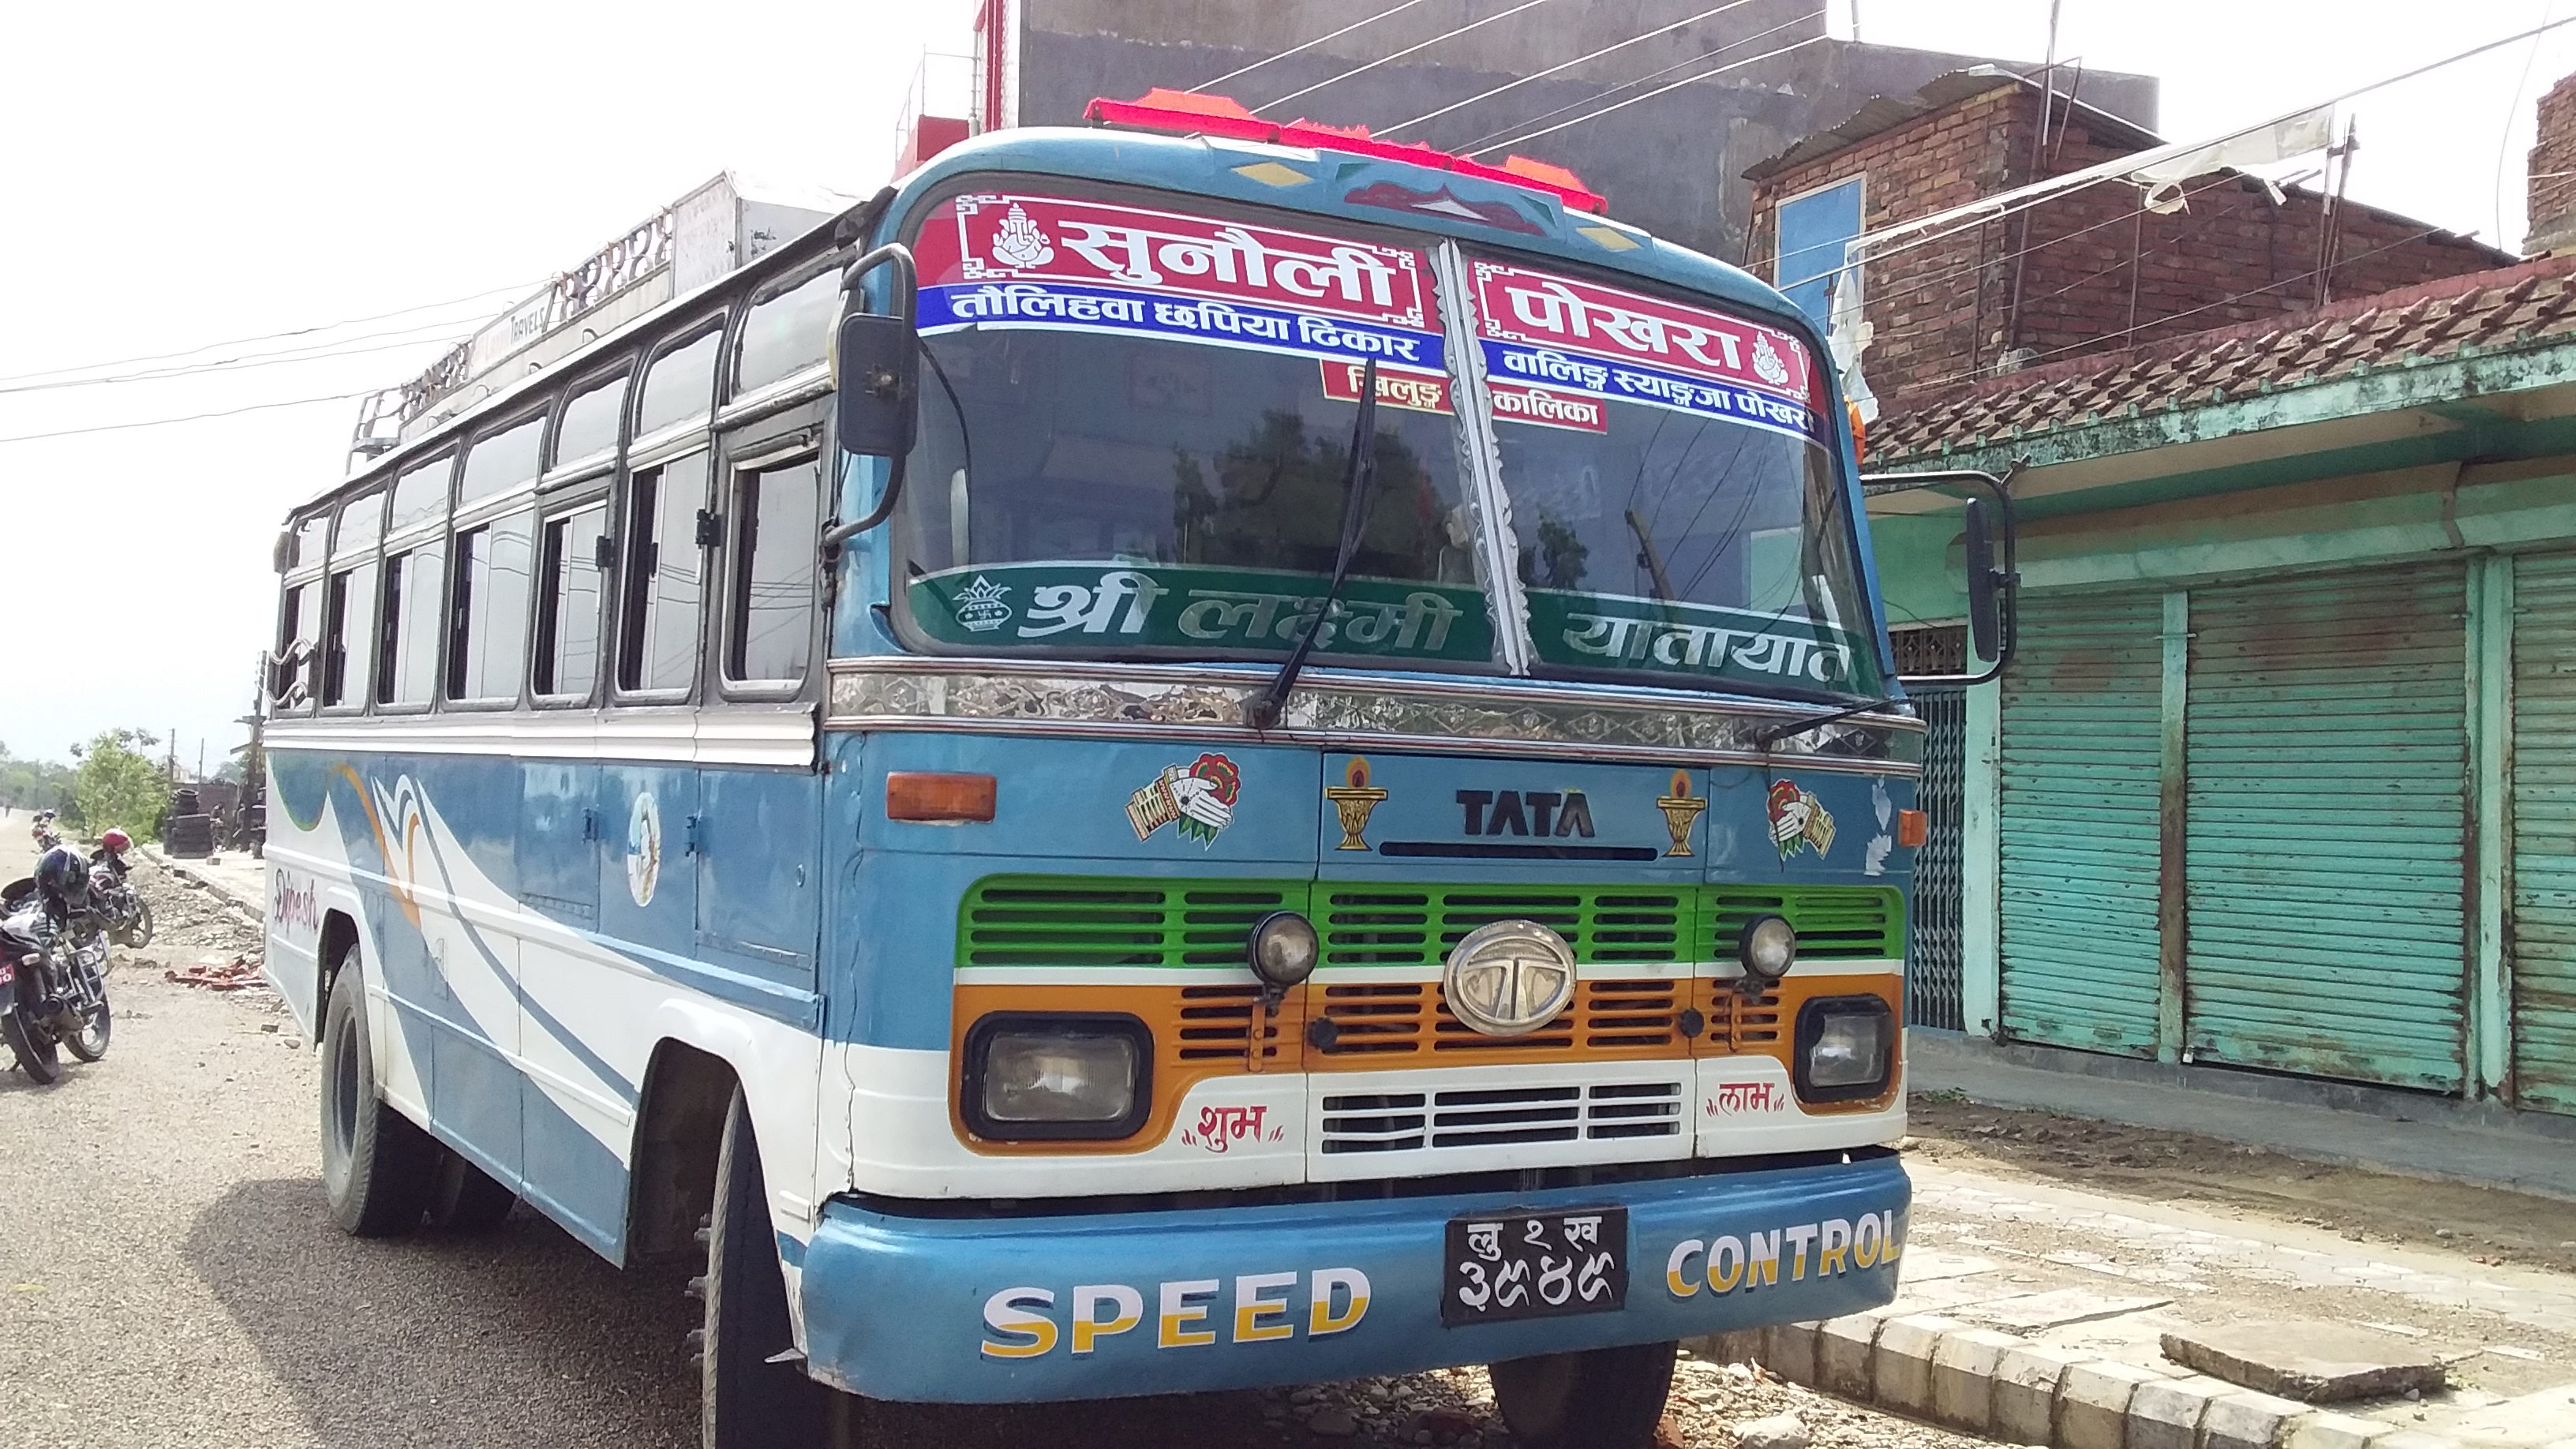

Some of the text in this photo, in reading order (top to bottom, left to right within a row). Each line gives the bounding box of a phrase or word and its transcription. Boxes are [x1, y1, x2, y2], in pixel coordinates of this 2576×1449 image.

[1058, 219, 1396, 306] सुनौली
[951, 285, 1145, 322] तौलिहवा
[1154, 301, 1290, 340] छपिया
[1504, 282, 1742, 371] पोखरा
[1492, 388, 1598, 425] कालिका
[1017, 571, 1168, 638] श्री
[1563, 612, 1853, 683] यातायात
[1456, 789, 1595, 837] TATA
[1719, 1082, 1775, 1117] लाभ
[1197, 1106, 1267, 1153] शुभ
[1467, 1216, 1602, 1261] लु २ ख
[980, 1209, 1900, 1358] SPEED CONTROL
